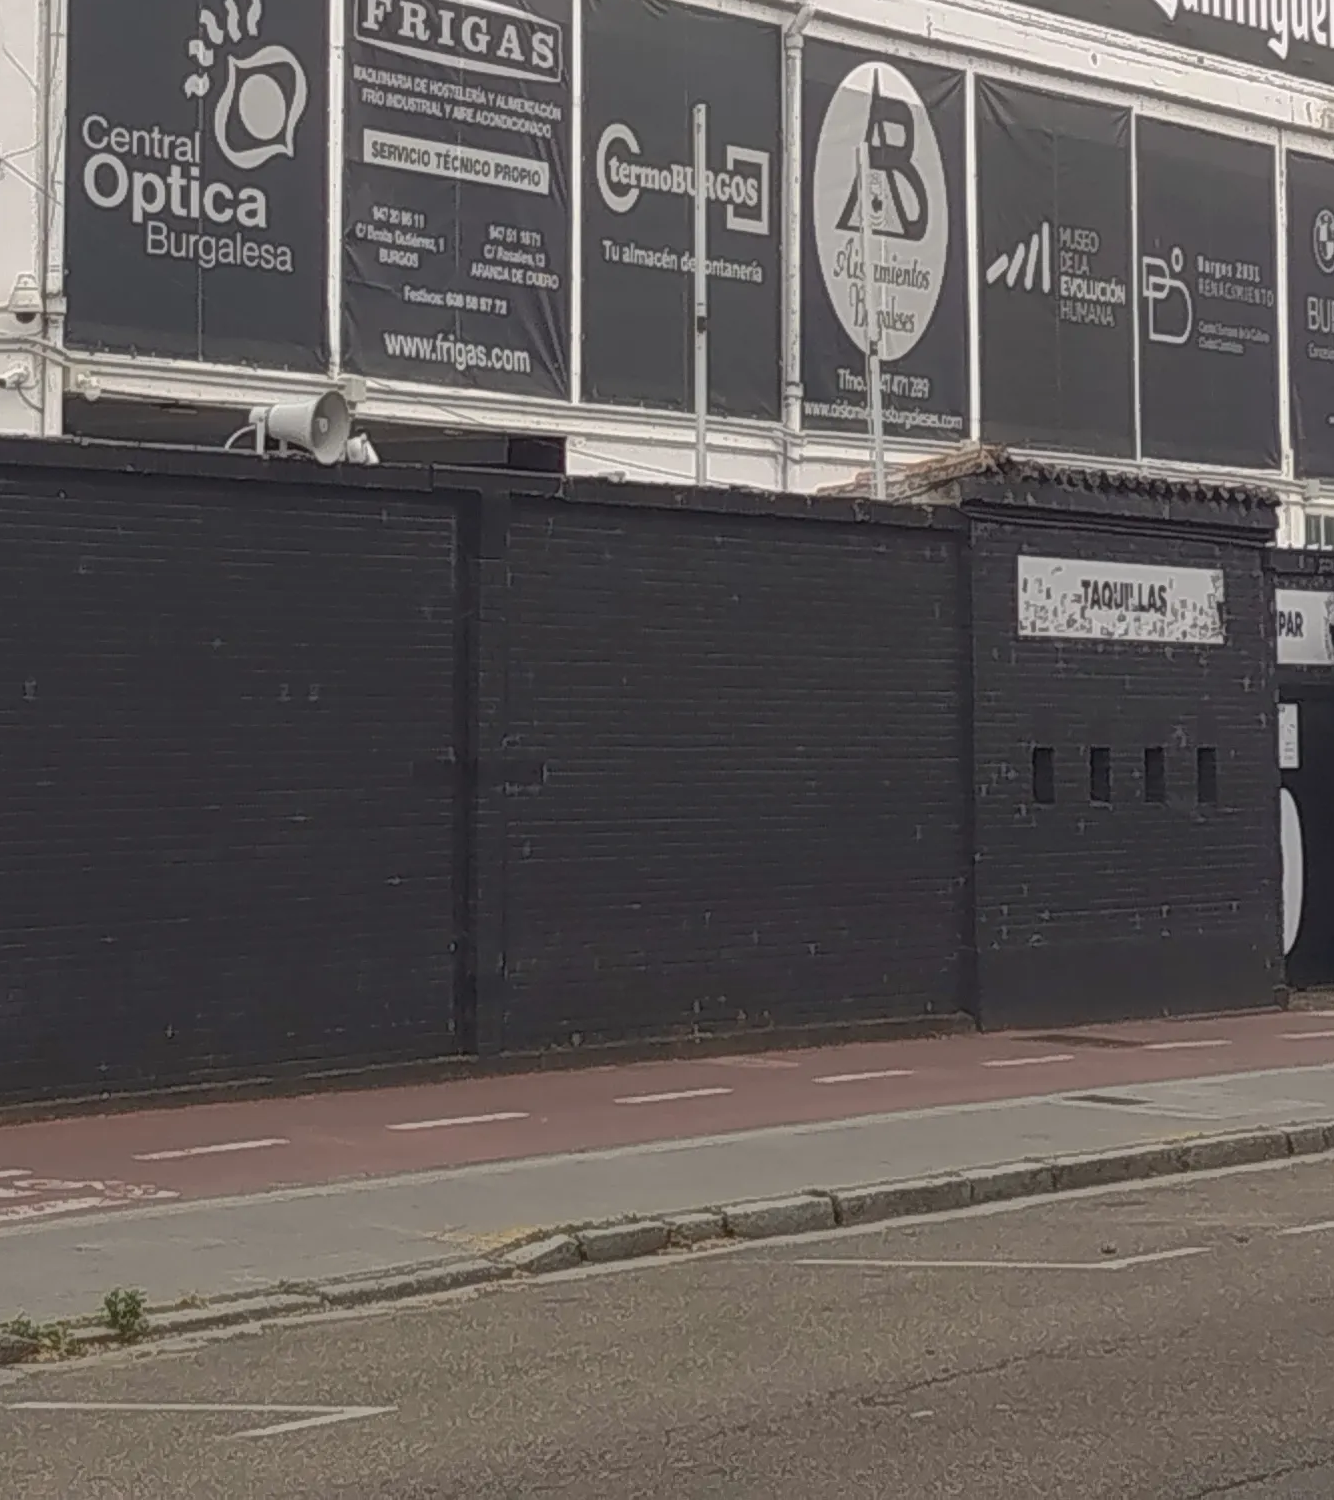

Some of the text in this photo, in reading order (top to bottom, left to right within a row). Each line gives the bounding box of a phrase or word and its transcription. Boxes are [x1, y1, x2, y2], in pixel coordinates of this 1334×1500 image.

[82, 114, 201, 164] Central
[371, 140, 541, 187] SERVICIO TÉCNICO PROPIO
[83, 153, 268, 229] Optica
[146, 220, 294, 273] Burgalesa
[602, 240, 619, 261] Tu
[622, 243, 678, 271] almacén
[703, 258, 762, 283] ontanería
[383, 332, 531, 372] www.frigas.com
[1080, 579, 1168, 613] TAQUILLAS
